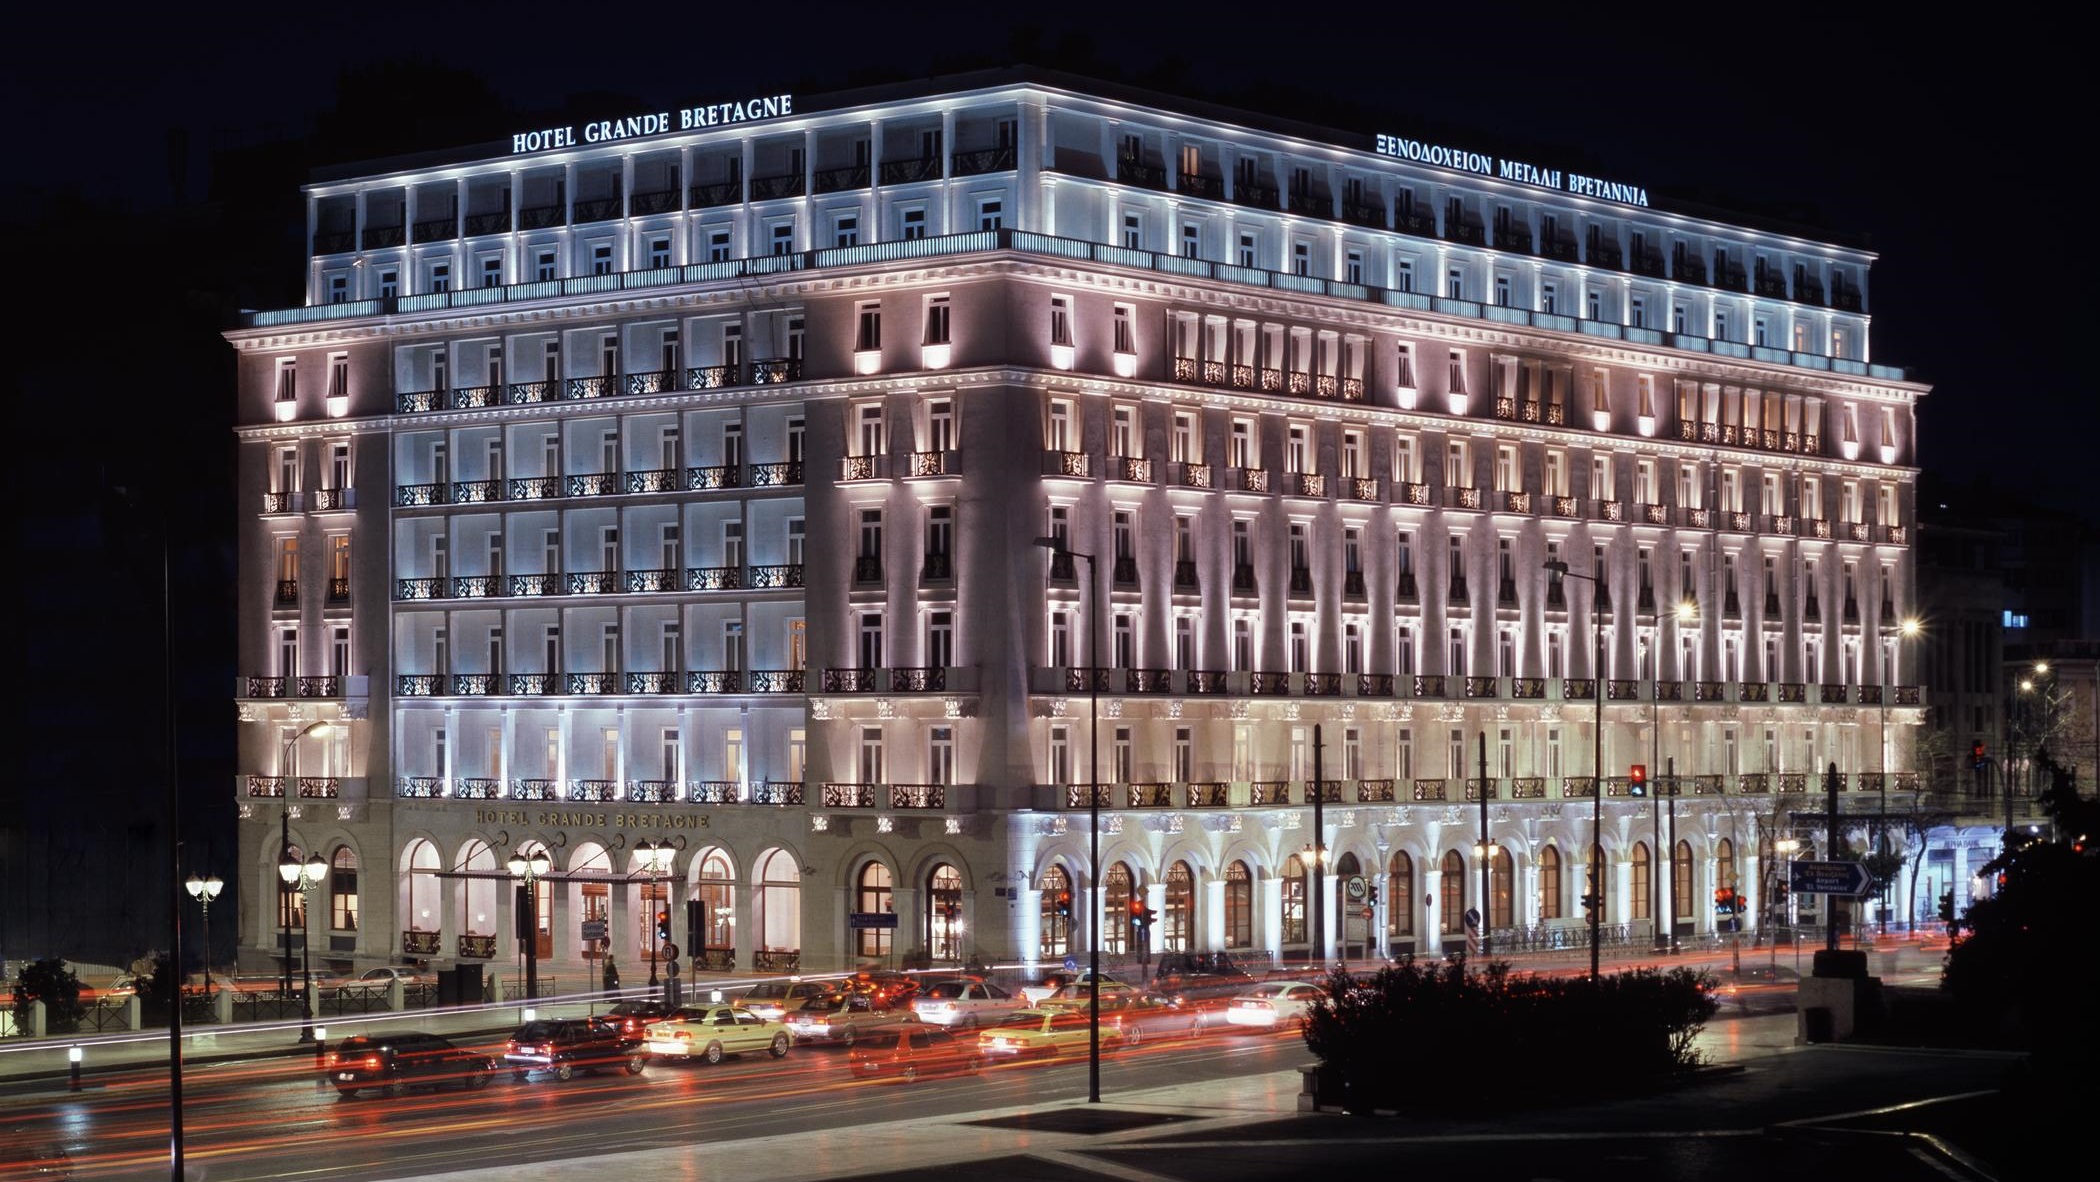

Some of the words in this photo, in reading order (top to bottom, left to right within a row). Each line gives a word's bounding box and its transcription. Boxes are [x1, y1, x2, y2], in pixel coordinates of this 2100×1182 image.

[513, 126, 576, 153] HOTEL
[585, 112, 669, 142] GRANDE
[681, 95, 792, 129] BRETAGNE
[1376, 134, 1492, 175] ΞΕΝΟΔΟΧΕΙΟΝ
[1499, 159, 1561, 189] ΜΕΓΑΛΗ
[1568, 173, 1649, 207] ΒΡΕΤΑΝΝΙΑ
[476, 810, 530, 825] HOTEL
[539, 812, 607, 827] GRANDE
[615, 814, 710, 828] BRETAGNE
